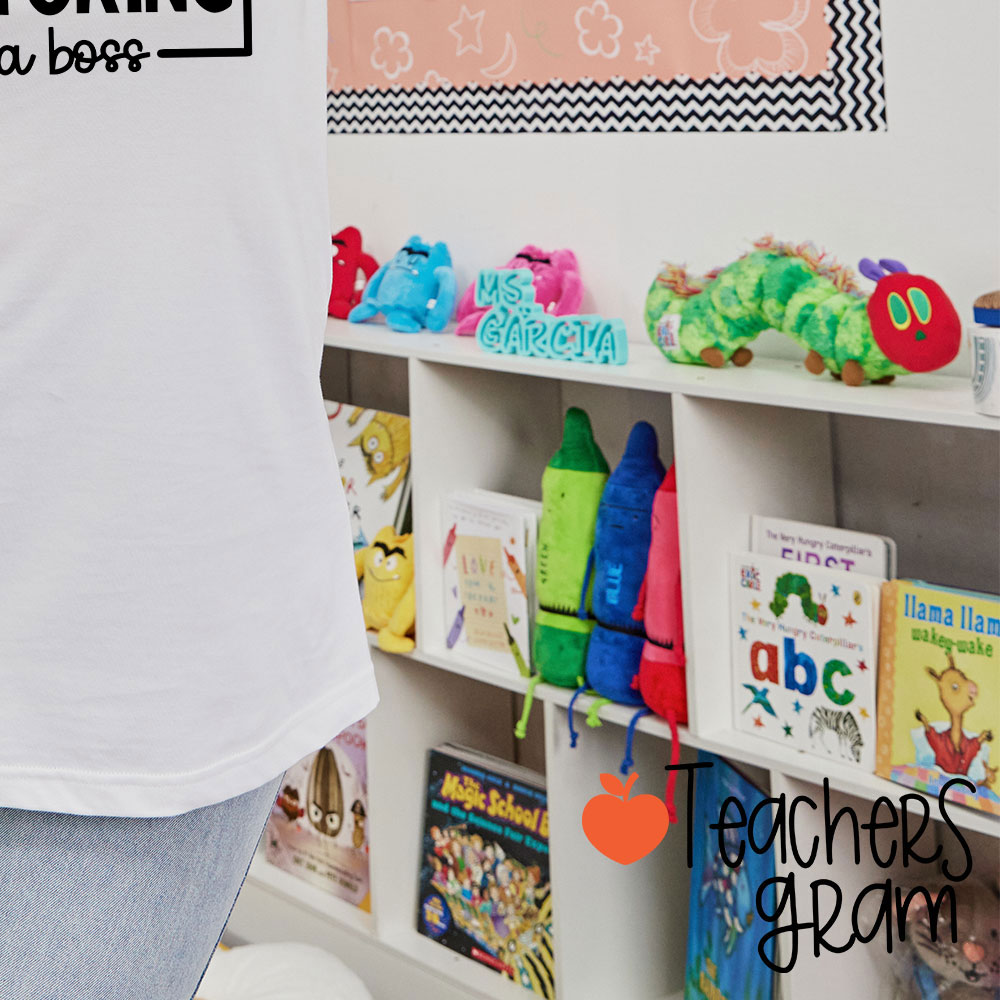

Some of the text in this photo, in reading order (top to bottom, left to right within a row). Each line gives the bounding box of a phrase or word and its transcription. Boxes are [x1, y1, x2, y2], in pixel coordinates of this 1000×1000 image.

[48, 26, 151, 75] boss
[479, 310, 618, 364] GARCIA
[904, 593, 954, 628] llama
[750, 636, 856, 706] abc
[441, 770, 488, 811] Magic
[487, 788, 540, 833] School
